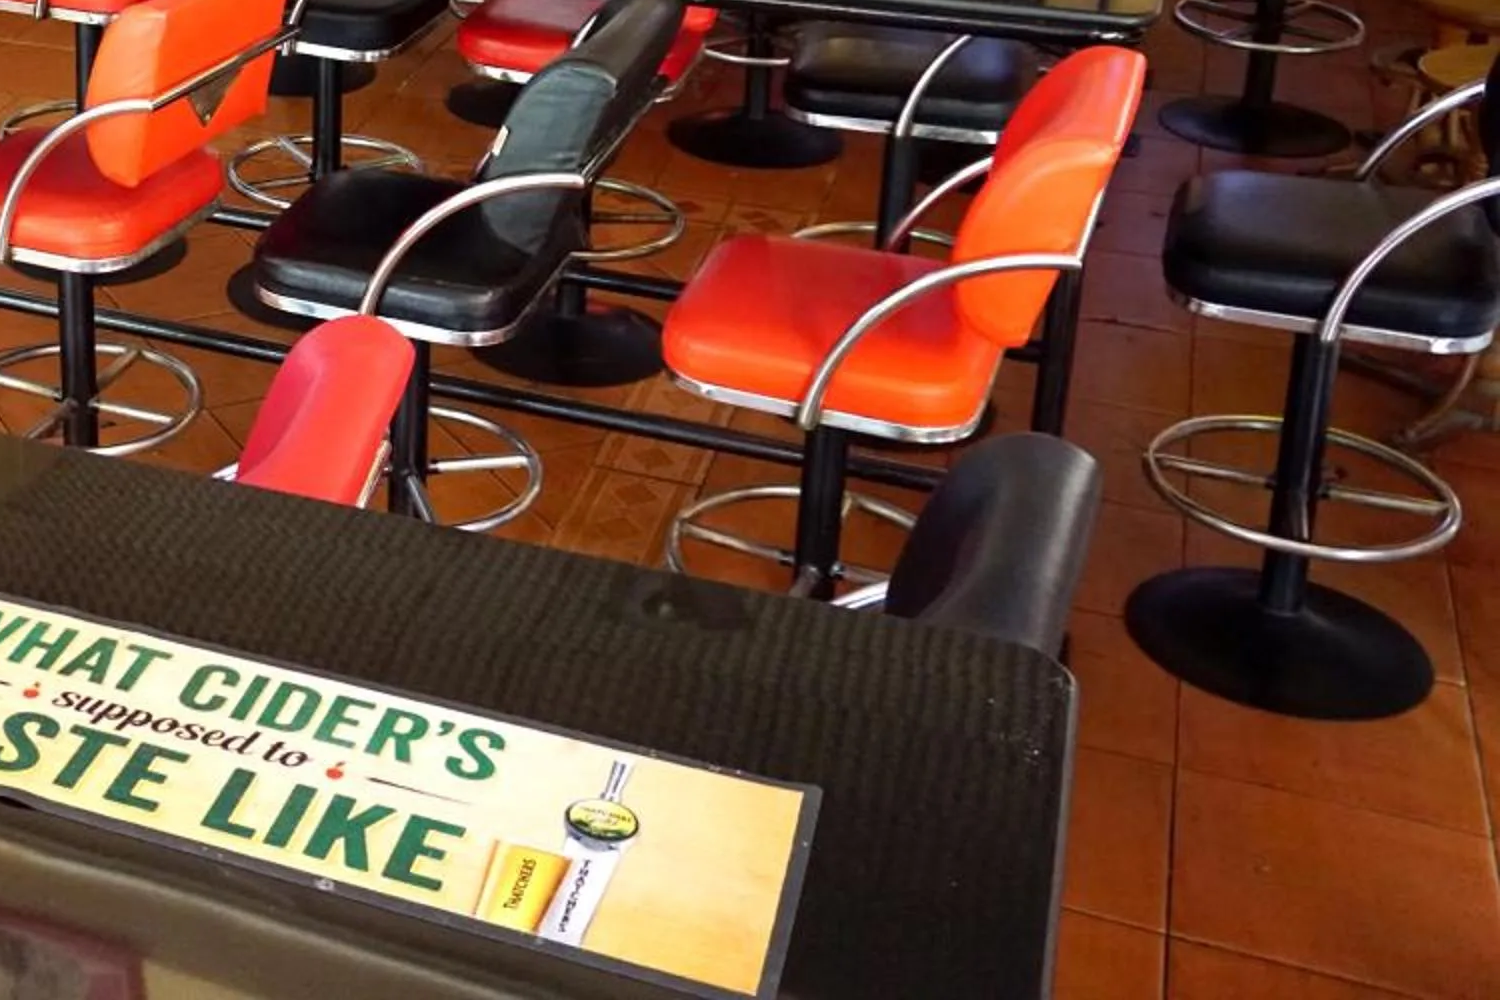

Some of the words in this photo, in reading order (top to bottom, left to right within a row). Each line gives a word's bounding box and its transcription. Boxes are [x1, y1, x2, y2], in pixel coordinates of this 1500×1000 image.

[52, 690, 262, 755] supposed
[262, 741, 312, 768] to
[178, 664, 506, 781] CIDER'S
[200, 768, 467, 892] LIKE
